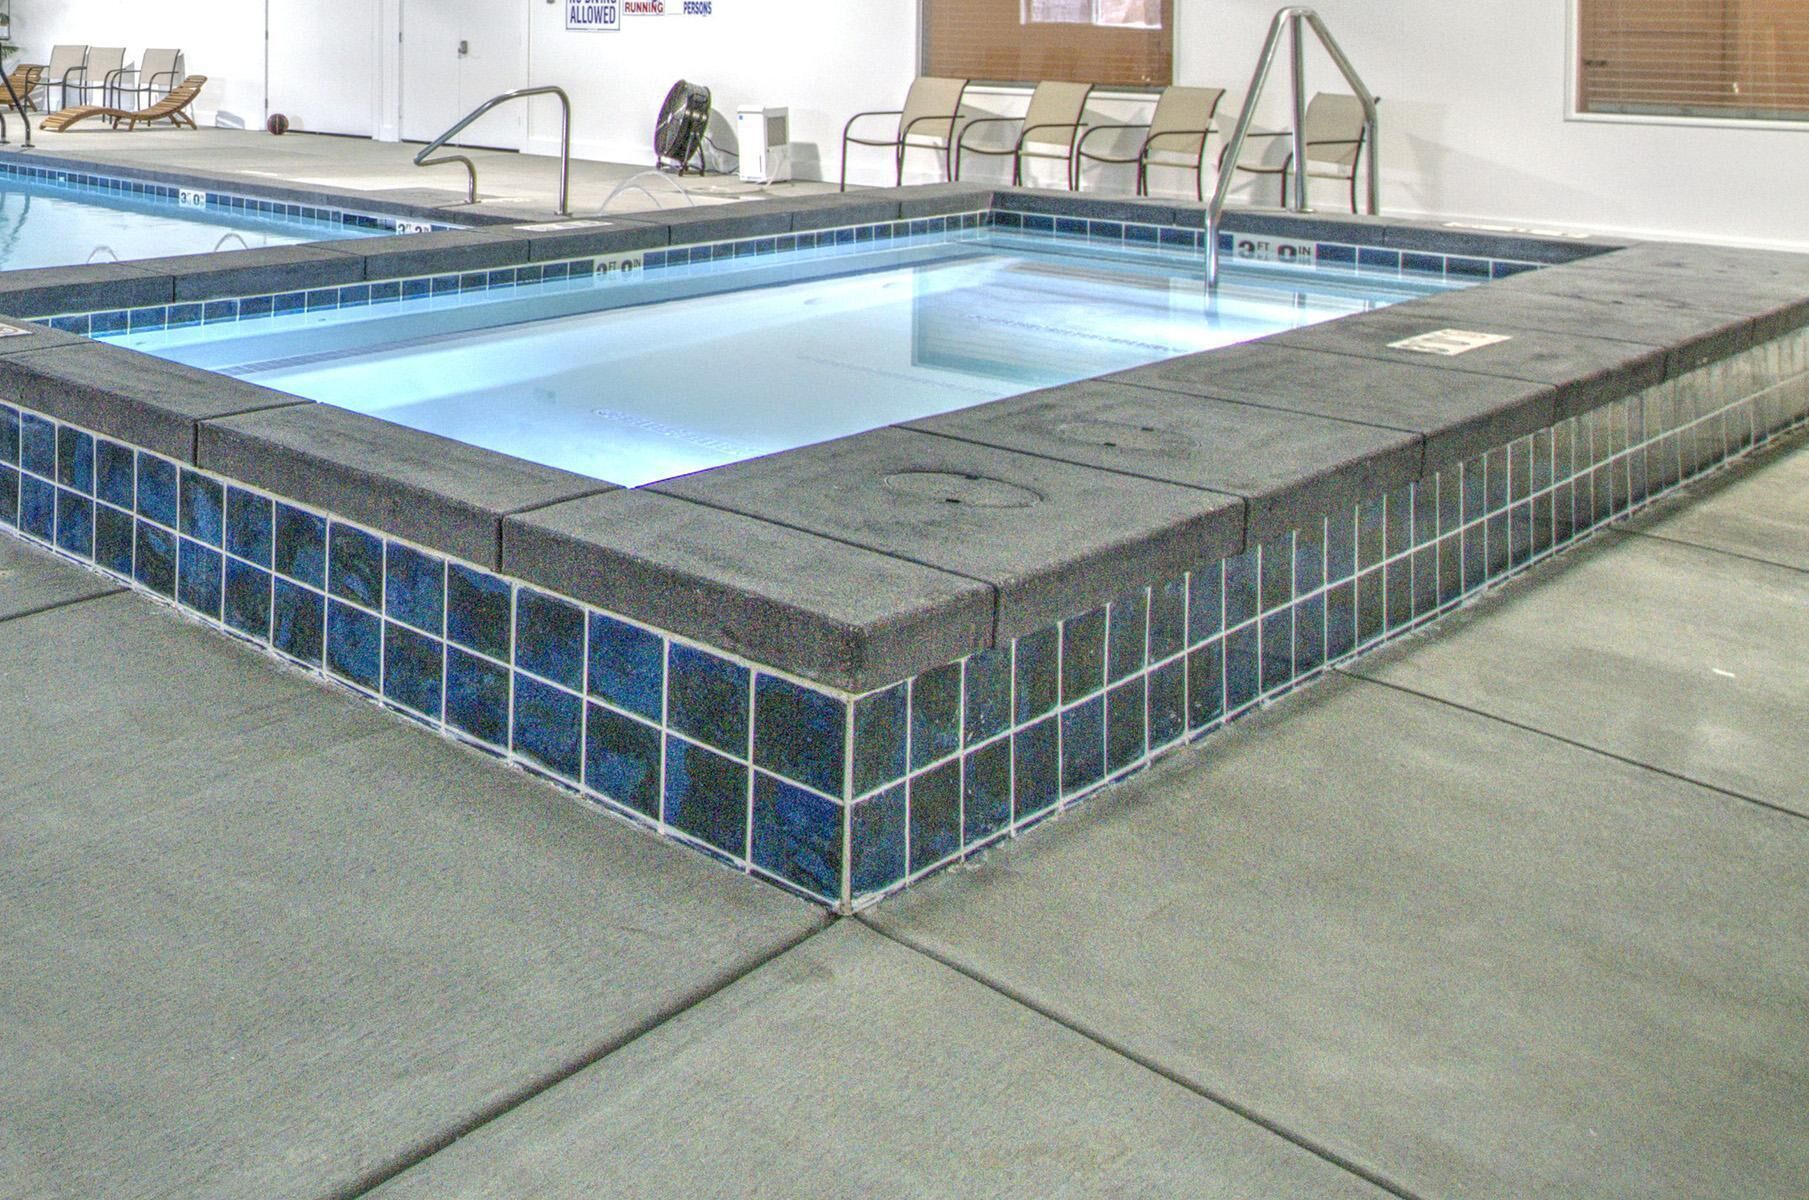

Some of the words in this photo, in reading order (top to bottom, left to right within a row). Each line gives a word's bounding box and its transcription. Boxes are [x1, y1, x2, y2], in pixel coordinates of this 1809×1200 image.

[625, 2, 663, 13] RUNNING
[683, 2, 712, 15] PERSONS
[570, 6, 616, 24] ALLOWED
